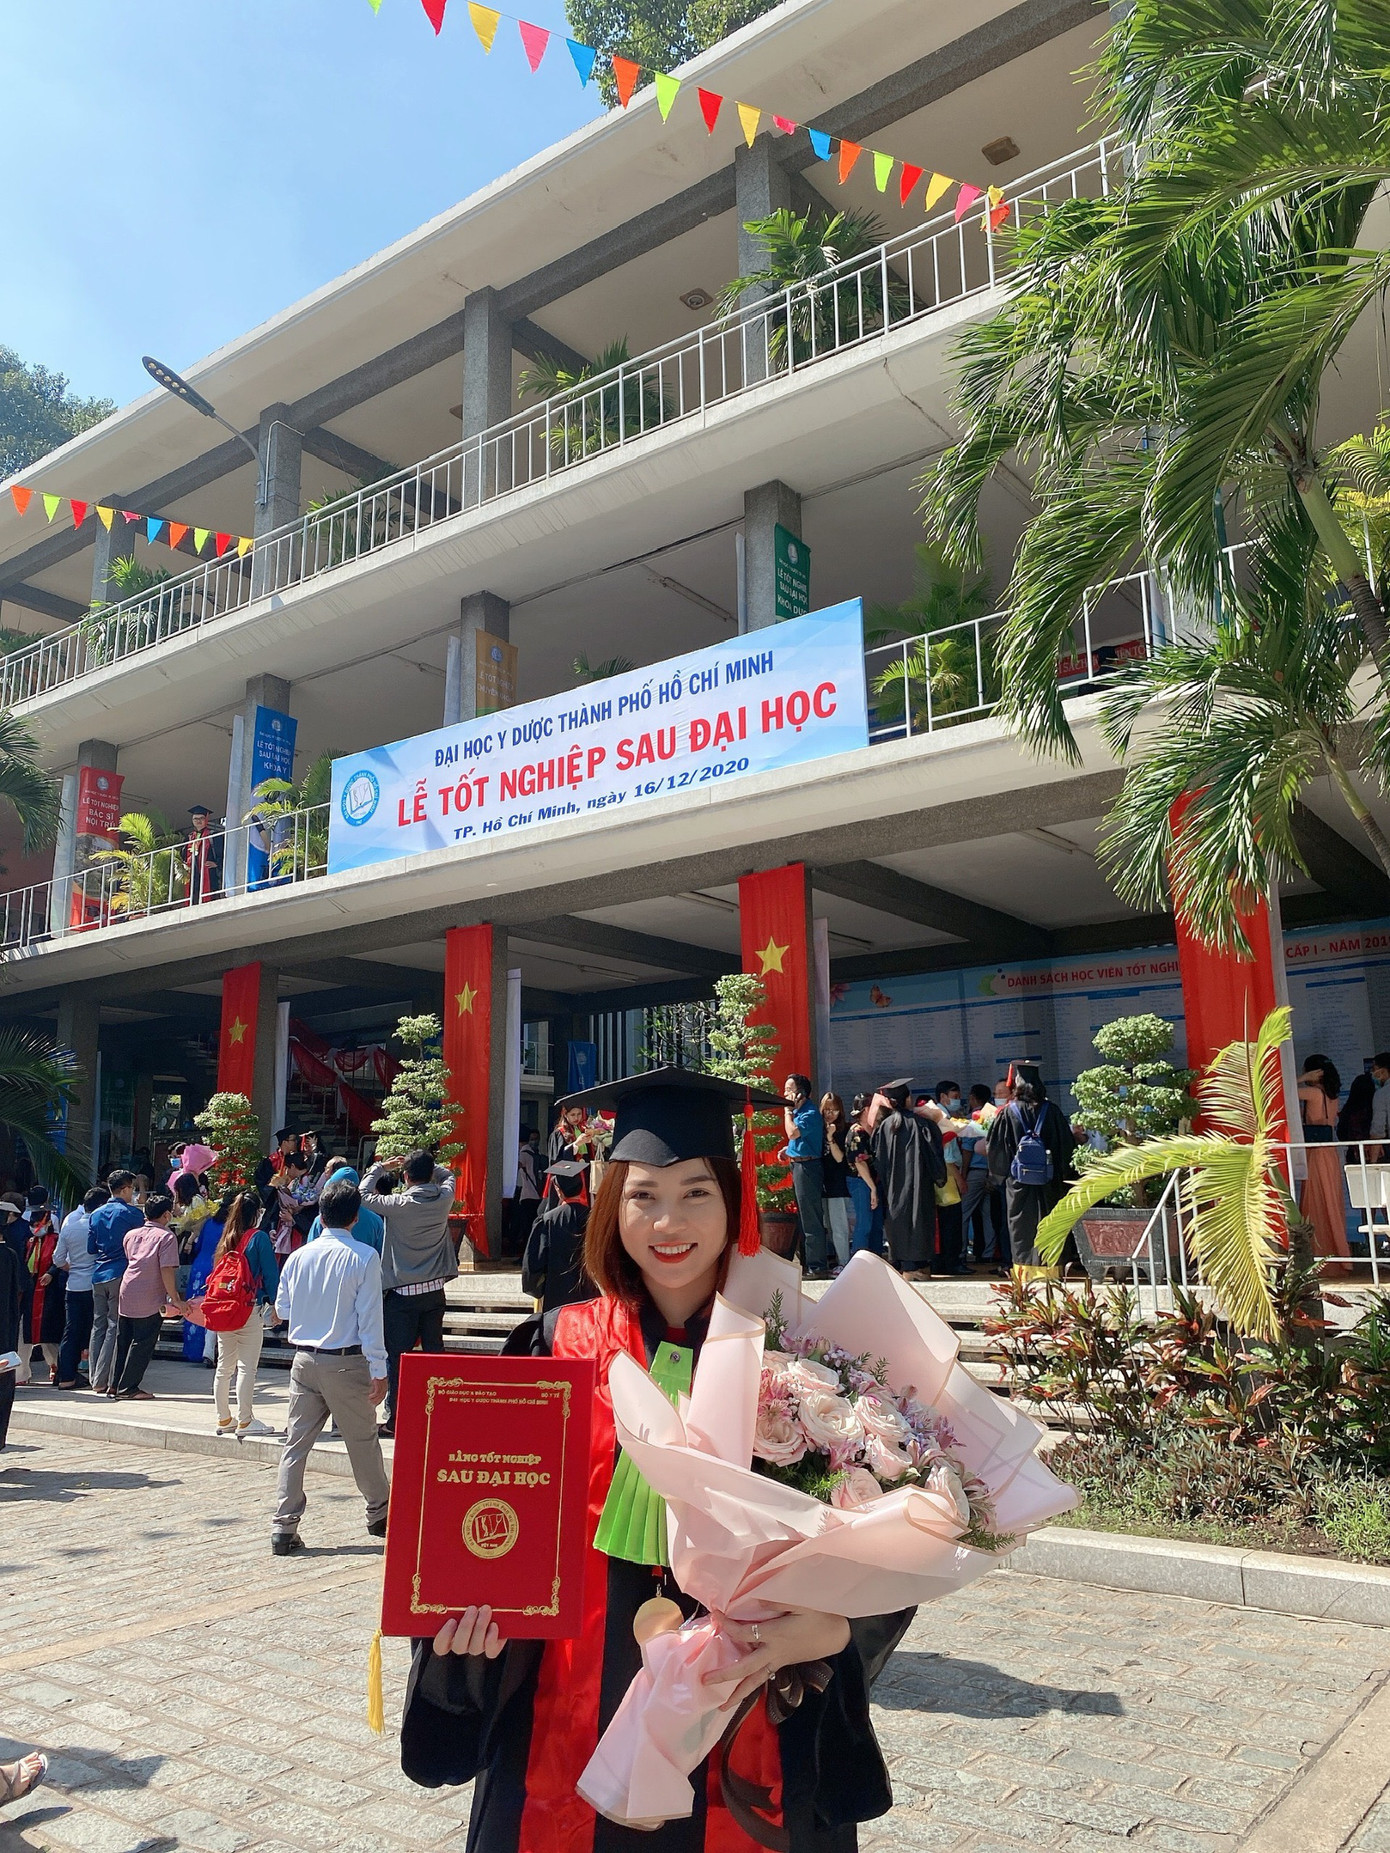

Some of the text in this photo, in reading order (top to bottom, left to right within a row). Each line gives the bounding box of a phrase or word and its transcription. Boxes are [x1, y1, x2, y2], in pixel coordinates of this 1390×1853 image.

[435, 650, 774, 768] ĐẠI HỌC Y DƯỢC THÀNH PHỐ HỒ CHÍ MINH
[398, 778, 428, 827] LỄ
[438, 768, 490, 816] TỐT
[500, 744, 606, 801] NGHIỆP
[616, 726, 676, 770] SAU
[689, 706, 746, 752] ĐẠI
[761, 682, 837, 733] HỌC
[454, 758, 750, 840] TP. Hồ Chí Minh, ngày 16/12/2020
[88, 808, 104, 818] BÁC
[1286, 942, 1310, 958] CẤP
[1328, 938, 1360, 954] NĂM
[1364, 935, 1390, 949] 201
[1007, 960, 1179, 988] DANH SÁCH HỌC VIÊN TỐT NGHI
[448, 1450, 542, 1466] BẰNG TỐT NGHIỆP
[436, 1469, 551, 1488] SAU ĐẠI HỌC
